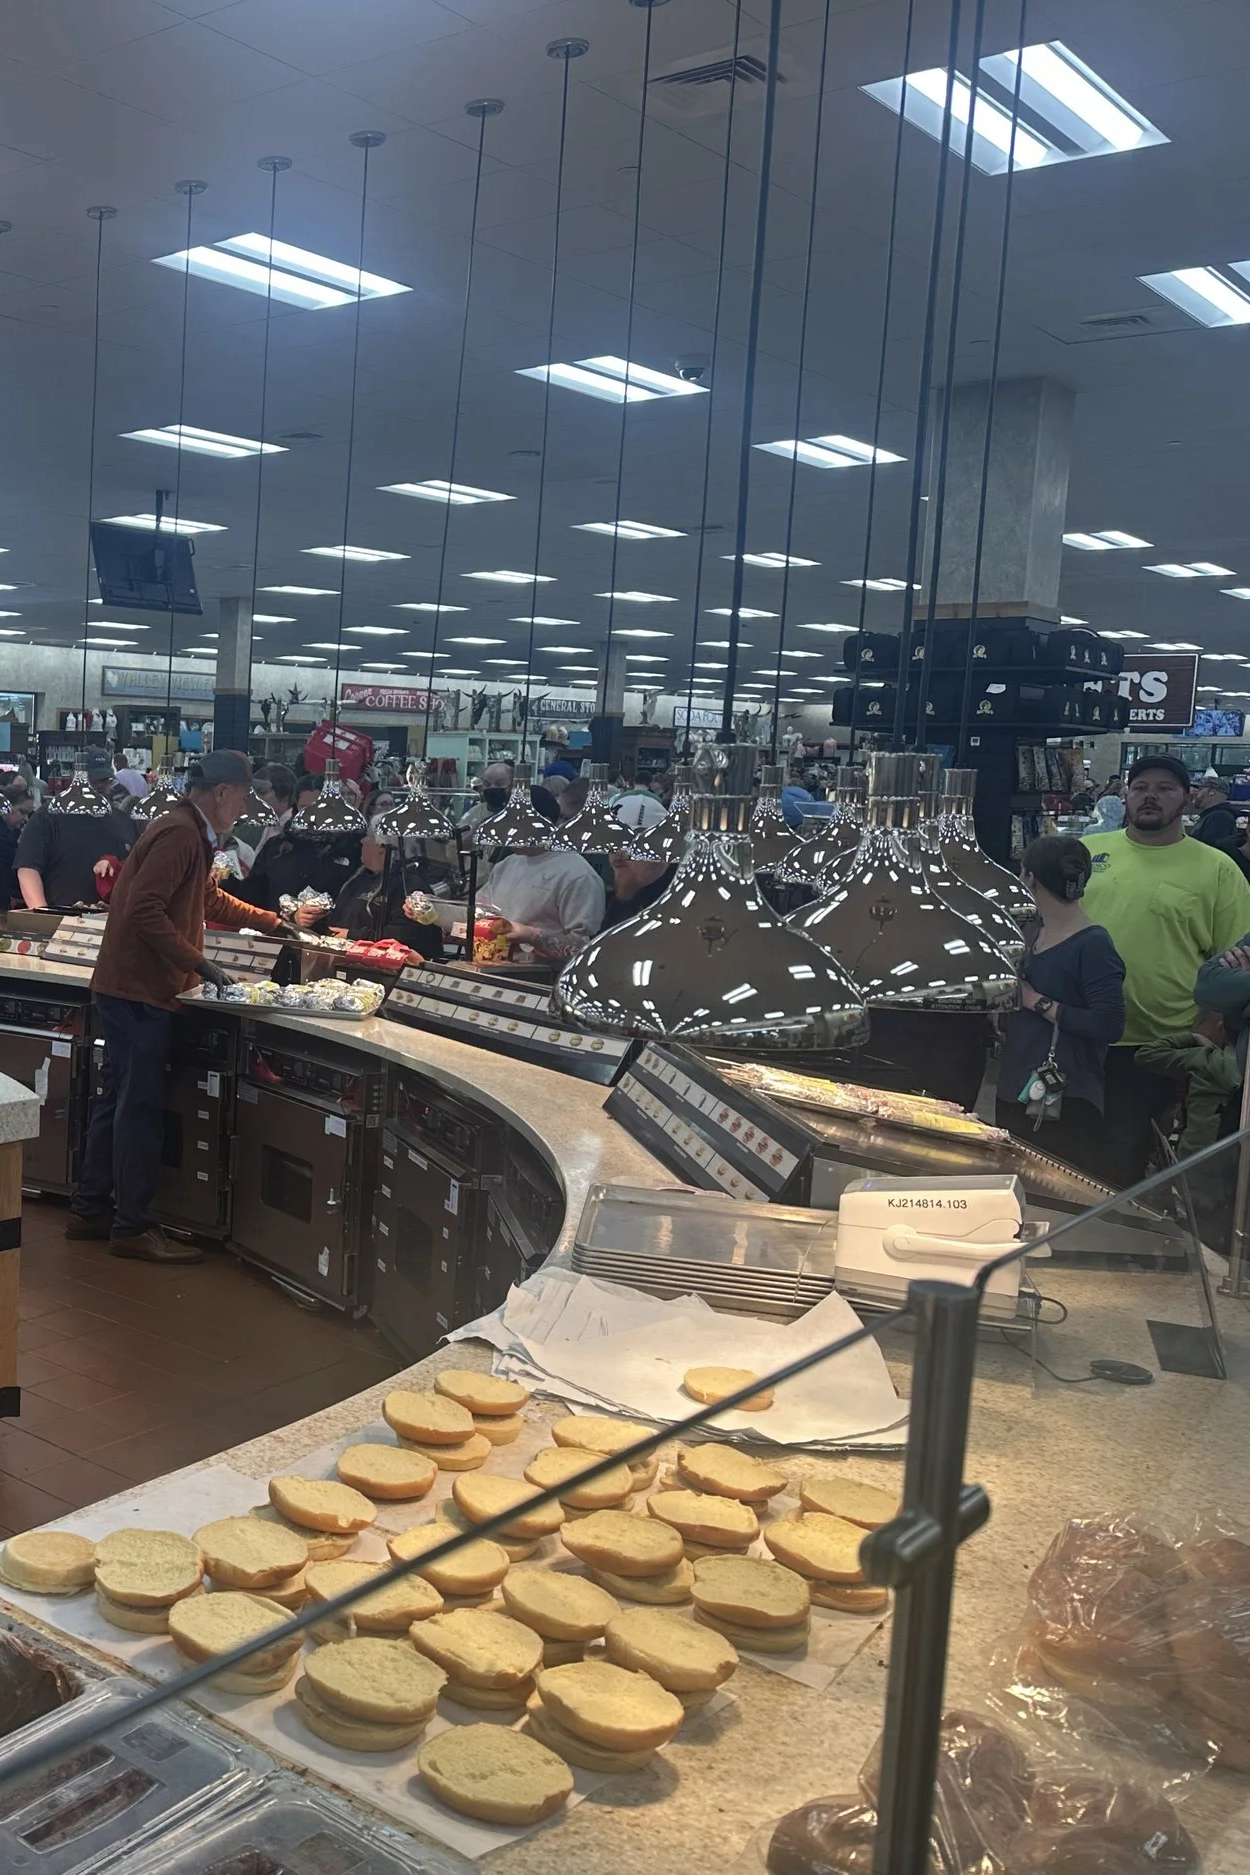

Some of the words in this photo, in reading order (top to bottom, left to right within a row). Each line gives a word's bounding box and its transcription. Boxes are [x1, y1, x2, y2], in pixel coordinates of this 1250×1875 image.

[366, 694, 416, 709] COFFEE
[419, 696, 447, 711] SHO
[540, 699, 578, 713] GENERAL
[676, 709, 702, 721] SODA
[703, 710, 723, 723] FOU
[888, 1198, 968, 1210] KJ214814.103
